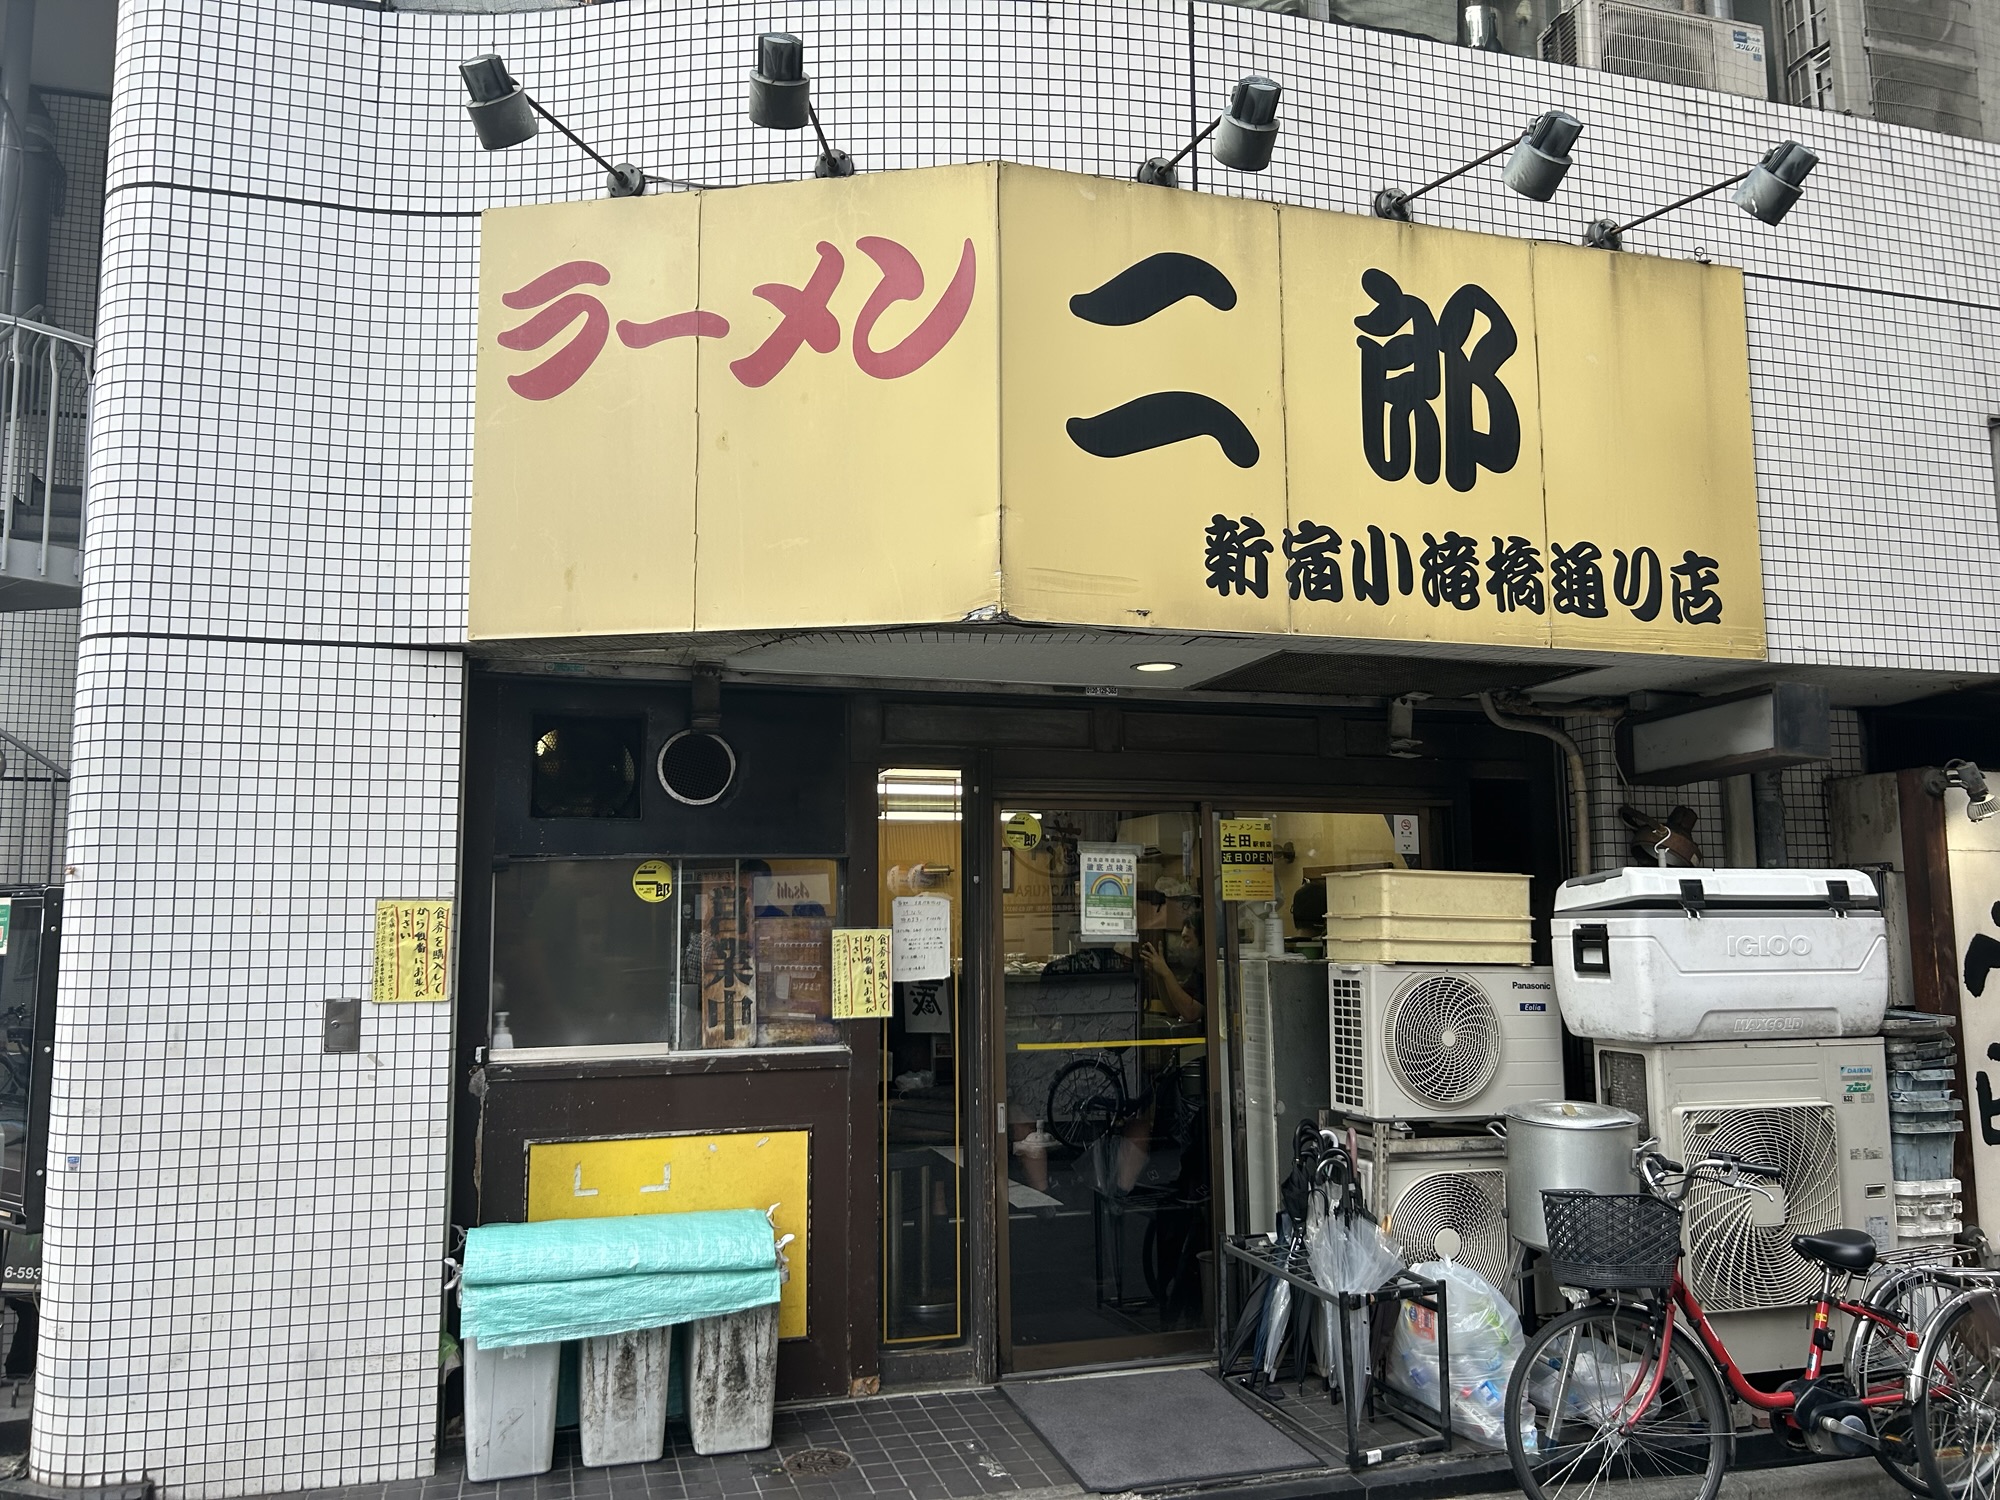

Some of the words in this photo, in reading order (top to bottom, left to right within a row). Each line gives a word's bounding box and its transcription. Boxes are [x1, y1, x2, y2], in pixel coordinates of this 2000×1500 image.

[497, 236, 977, 401] ラーメン
[1066, 251, 1521, 493] 二郎
[1203, 513, 1722, 626] 新宿小滝橋通り店
[1006, 820, 1037, 847] 二郎
[1221, 823, 1272, 831] ラーメン二郎
[636, 870, 670, 897] 二郎
[1726, 934, 1813, 958] IGLOO
[702, 885, 756, 1041] 営業中
[1512, 981, 1551, 991] Panasonic
[1524, 1003, 1542, 1012] Eolia
[1733, 1016, 1805, 1033] MAXCOLD
